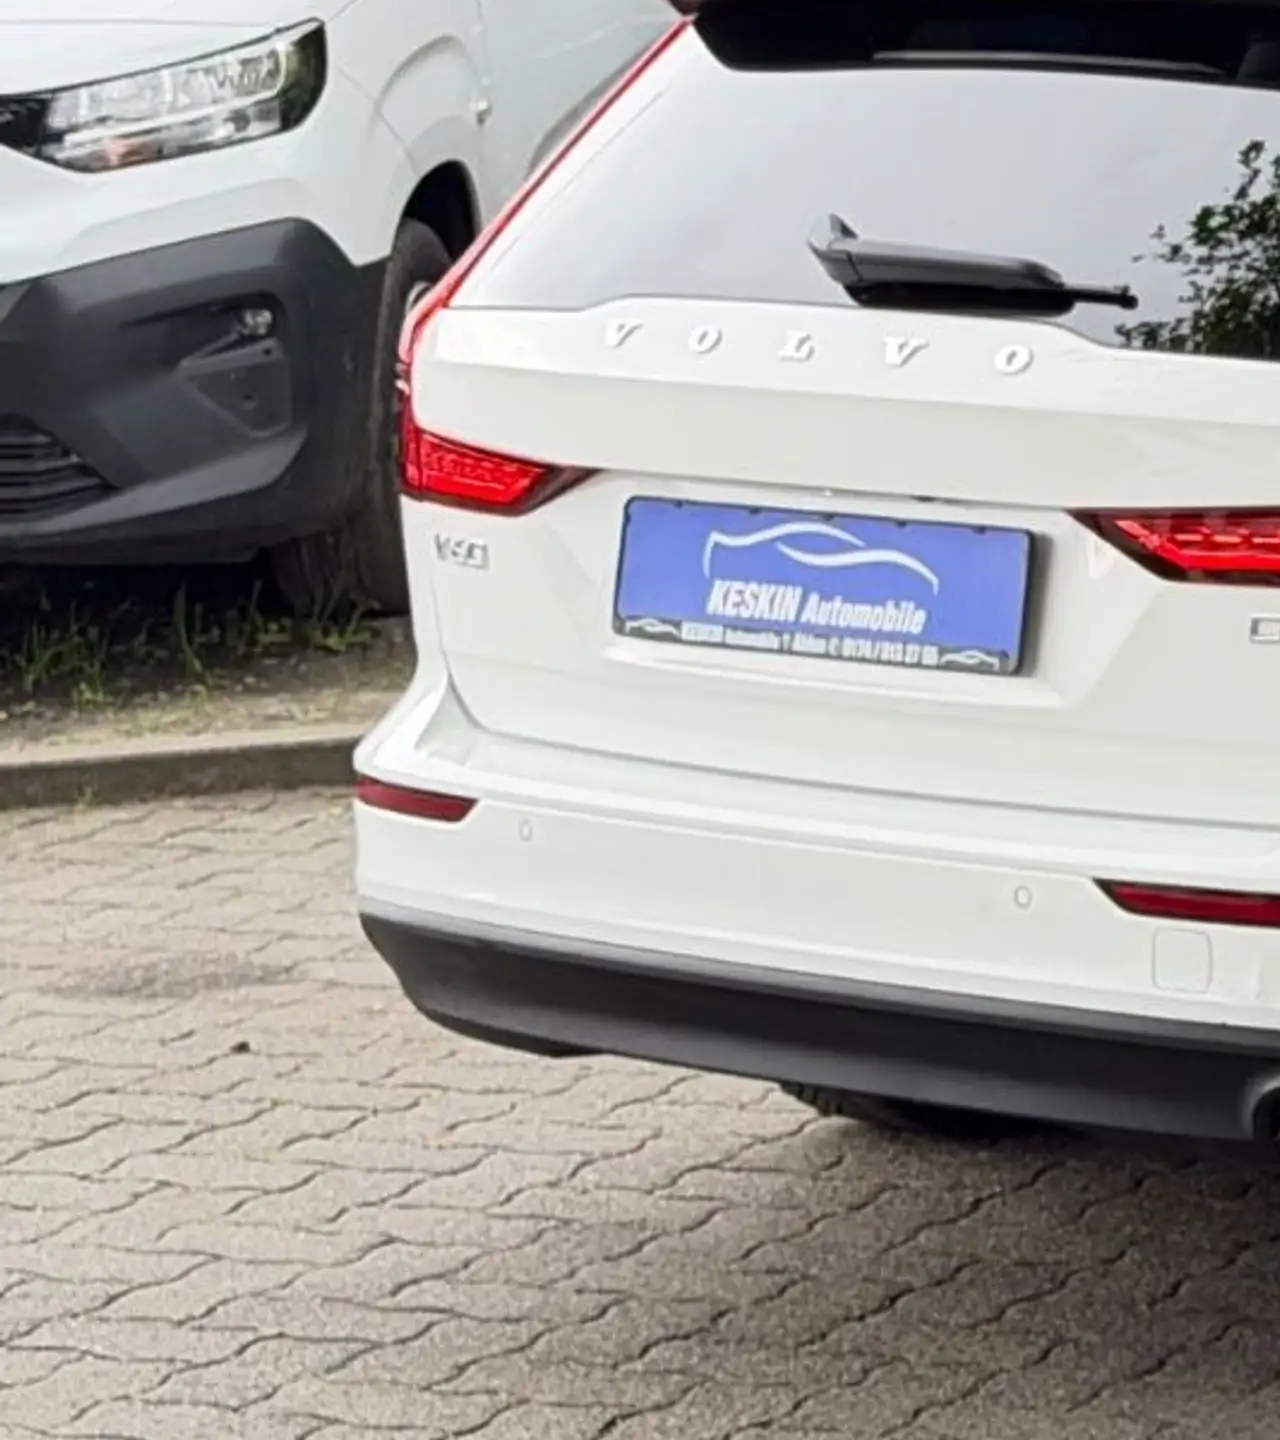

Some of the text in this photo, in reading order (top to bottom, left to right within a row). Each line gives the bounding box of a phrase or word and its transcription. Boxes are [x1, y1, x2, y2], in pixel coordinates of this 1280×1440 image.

[604, 316, 1034, 376] VOLVO
[706, 578, 927, 636] KESKIN Automobile
